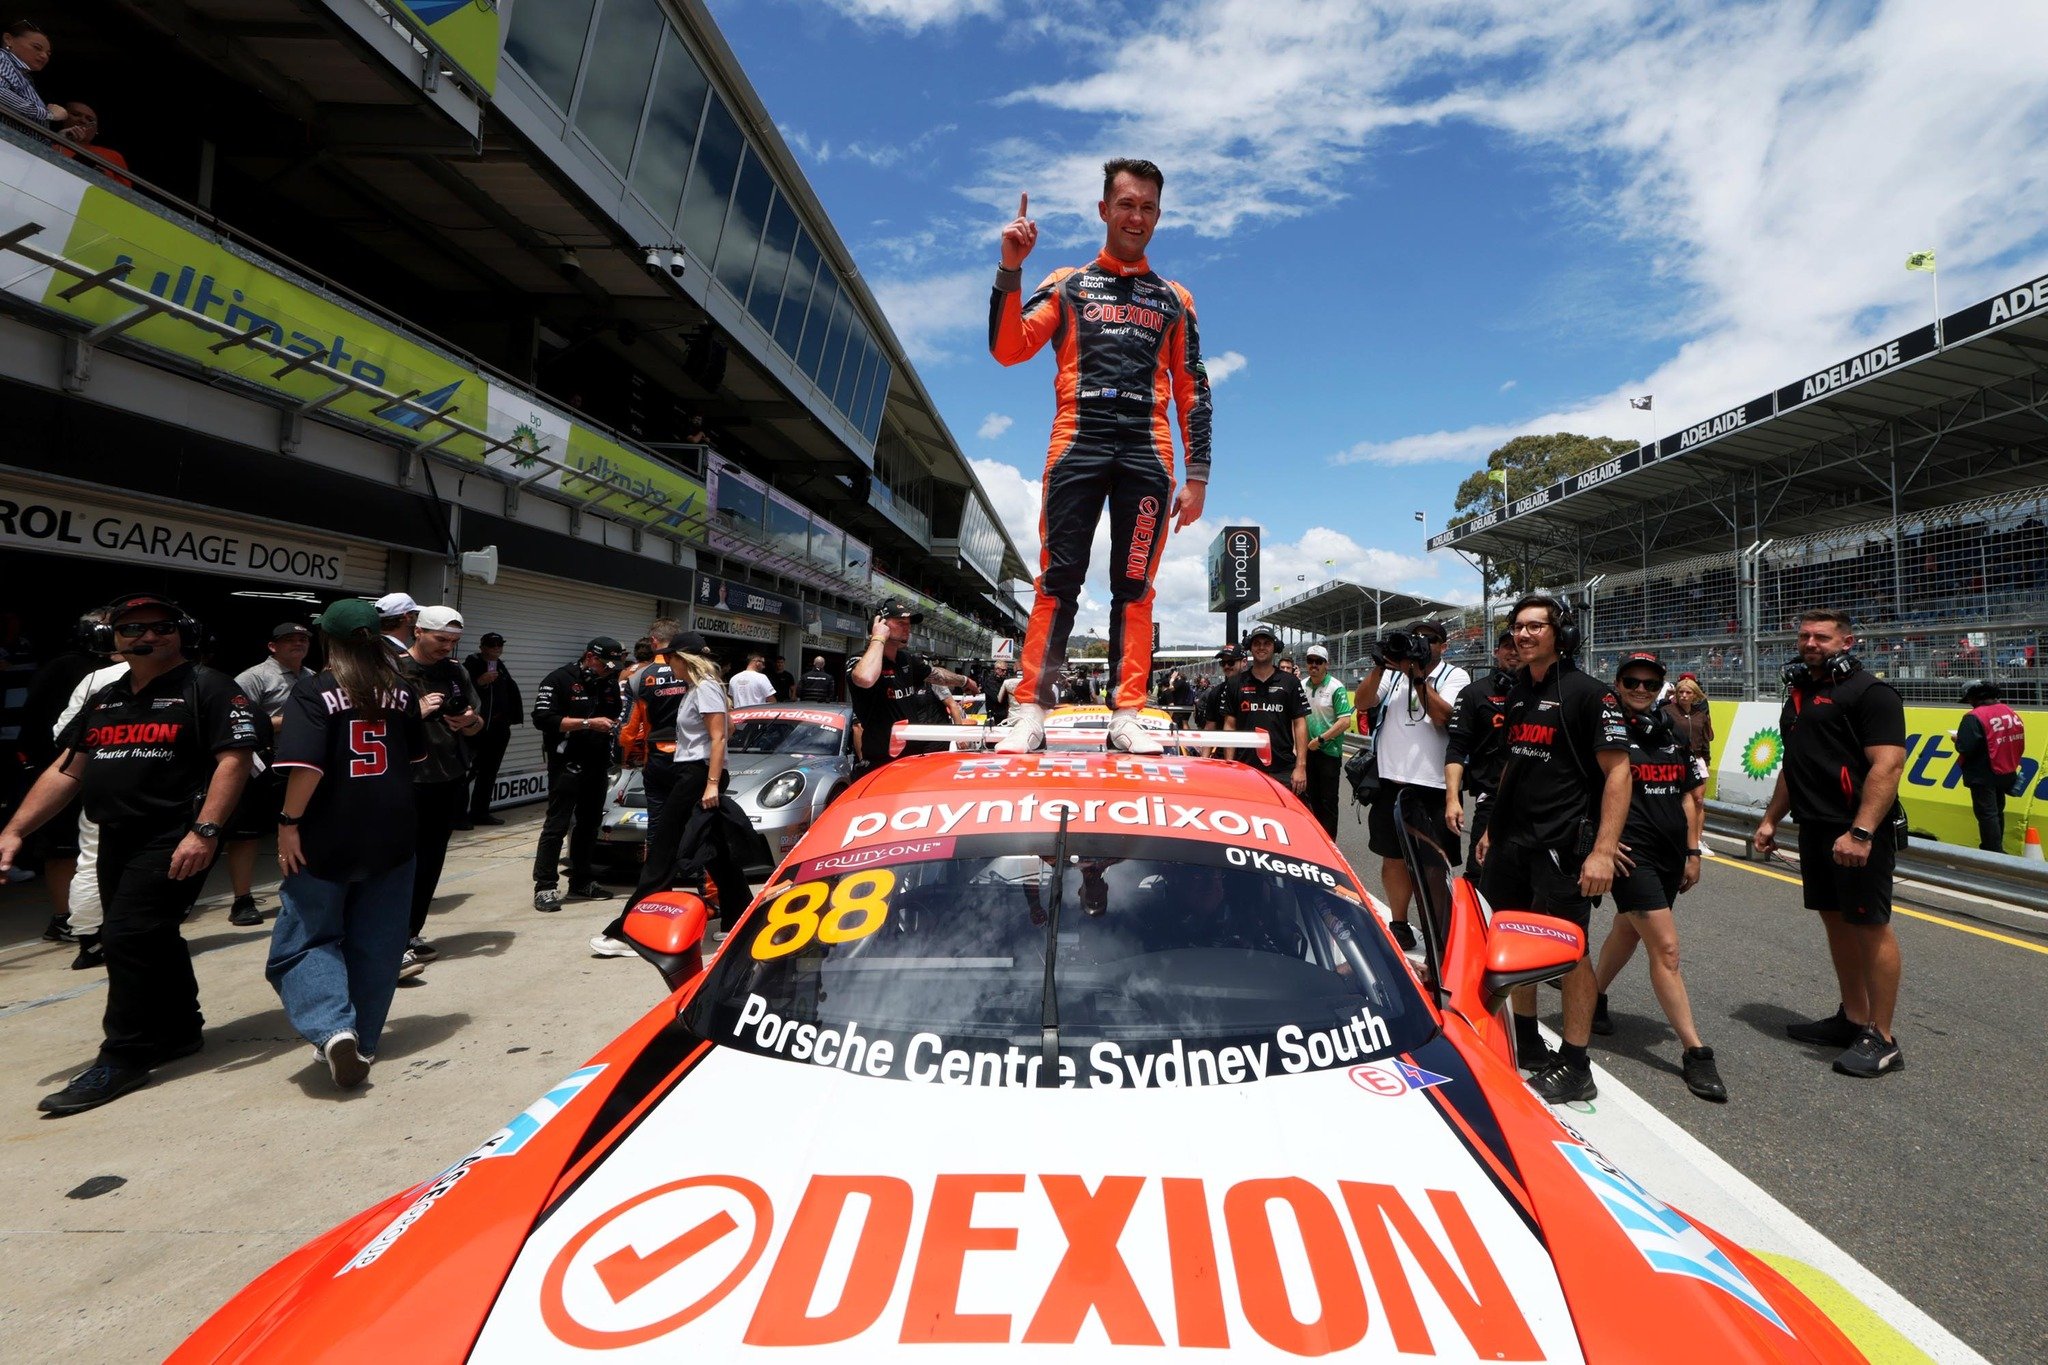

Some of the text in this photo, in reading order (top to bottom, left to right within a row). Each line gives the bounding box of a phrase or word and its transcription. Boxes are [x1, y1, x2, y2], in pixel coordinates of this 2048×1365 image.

[1100, 323, 1131, 335] Smarter
[1102, 303, 1164, 333] DEXION
[1803, 341, 1900, 401] ADELAIDE
[530, 411, 542, 428] bp
[1680, 406, 1747, 449] ADELAIDE
[1577, 458, 1622, 491] ADELAIDE
[1515, 489, 1550, 515] ADELAIDE
[1470, 511, 1498, 533] ADELAIDE
[93, 517, 239, 566] GARAGE
[249, 543, 339, 580] DOORS
[1126, 514, 1157, 581] DEXION
[1432, 530, 1455, 548] ADELAIDE
[1235, 534, 1251, 598] airtouch
[697, 617, 730, 633] GLIDEROL
[730, 710, 834, 723] aynterdixon
[101, 724, 179, 746] DEXION
[350, 720, 388, 777] 5
[94, 748, 130, 760] Smarter
[953, 771, 1187, 784] MOTORSPORT
[840, 793, 1290, 848] paynterdixon
[1226, 847, 1336, 887] O'Keeffe
[751, 868, 896, 961] 88
[733, 993, 1393, 1089] Porsche Centre Sydney South
[742, 1173, 1548, 1362] DEXION
